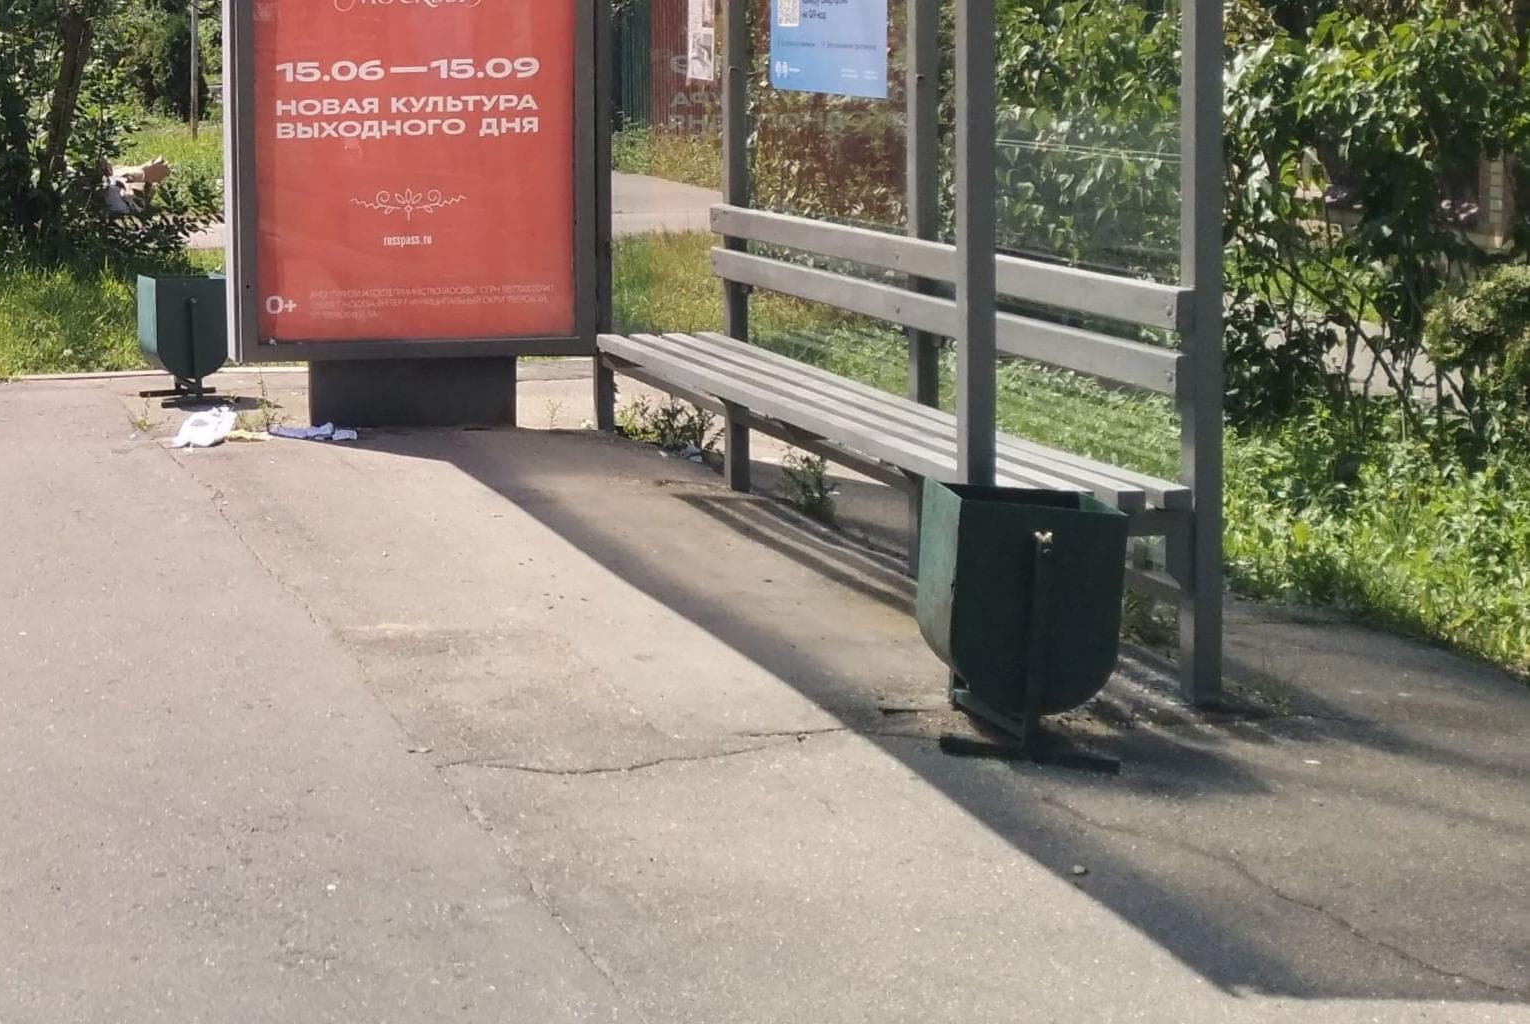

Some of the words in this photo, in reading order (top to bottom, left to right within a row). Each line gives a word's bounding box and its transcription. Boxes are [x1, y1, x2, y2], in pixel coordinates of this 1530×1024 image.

[275, 96, 380, 116] НОВАЯ
[390, 93, 539, 114] КУЛЬТУРА
[275, 118, 467, 140] ВЫХОДНОГО
[478, 116, 539, 137] ДНЯ
[382, 234, 433, 249] russpass.ru
[265, 295, 298, 315] 0+
